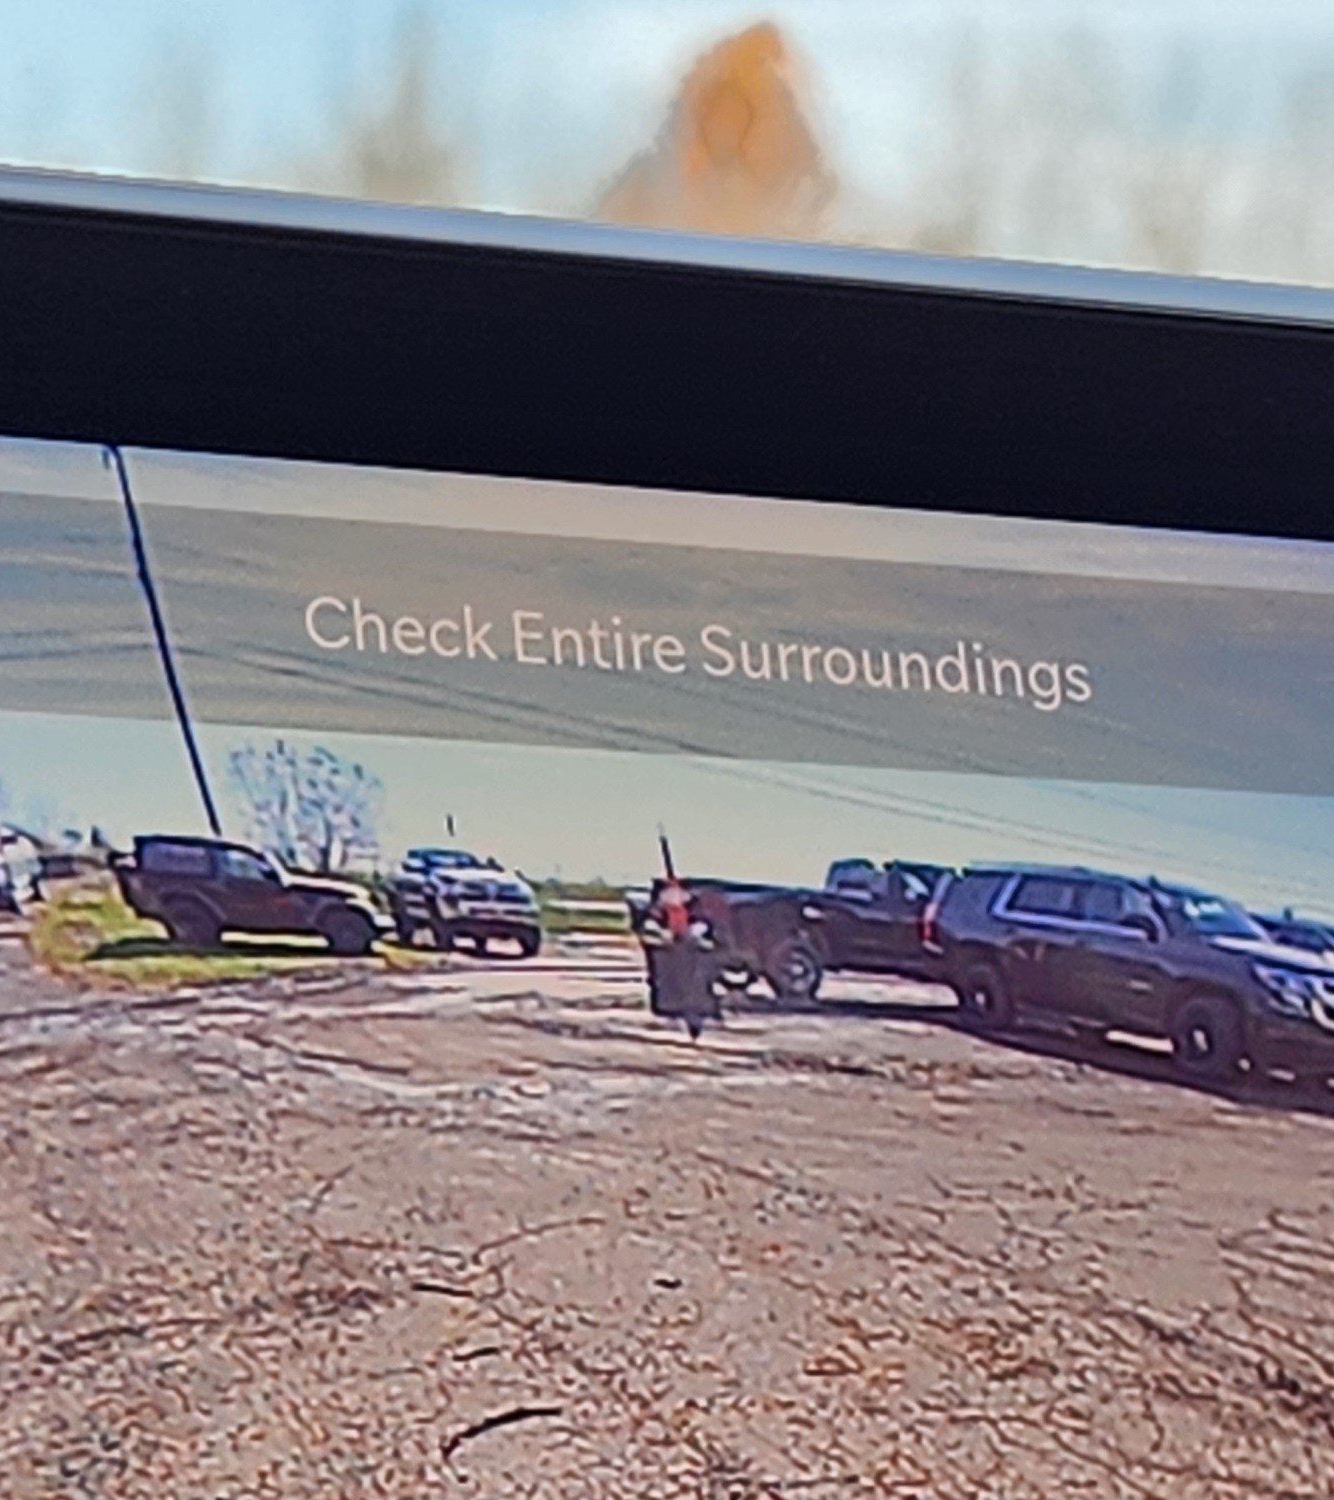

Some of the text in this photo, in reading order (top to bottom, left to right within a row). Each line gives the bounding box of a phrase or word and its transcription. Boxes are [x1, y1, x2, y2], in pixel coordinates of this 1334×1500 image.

[304, 596, 1093, 711] Check Entire Surroundings
